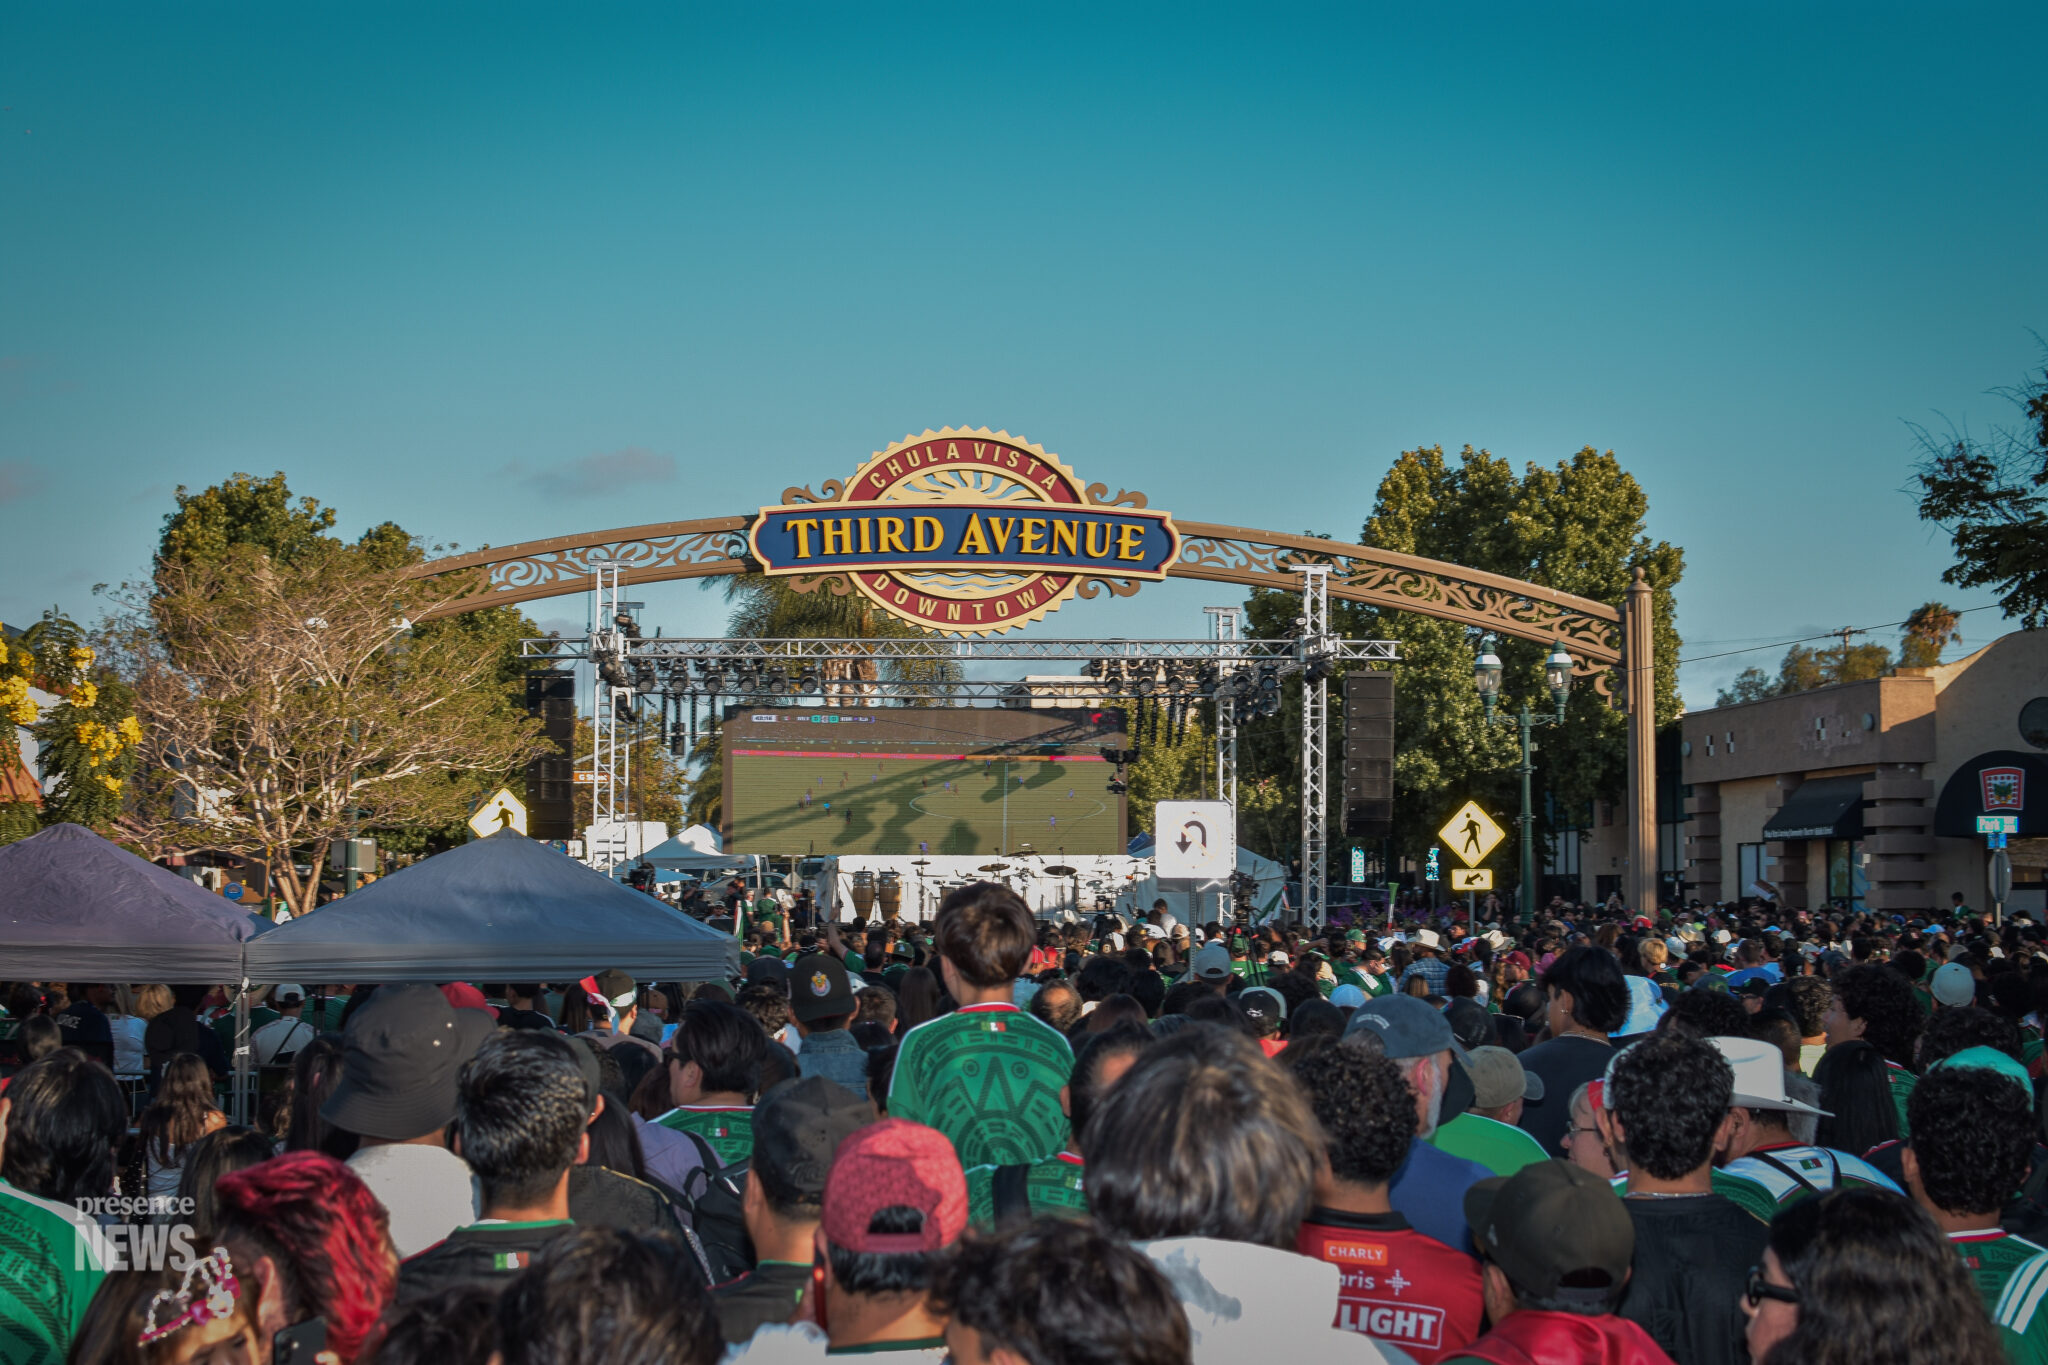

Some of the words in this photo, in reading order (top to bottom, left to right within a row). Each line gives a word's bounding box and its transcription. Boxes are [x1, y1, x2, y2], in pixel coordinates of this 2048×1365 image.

[869, 442, 960, 489] CHULA
[974, 442, 1059, 491] VISTA
[786, 515, 945, 559] THIRD
[958, 512, 1146, 561] AVENUE
[872, 574, 1061, 621] DOWNTOWN
[1328, 1245, 1384, 1260] CHARLY
[1340, 1303, 1438, 1340] LIGHT
